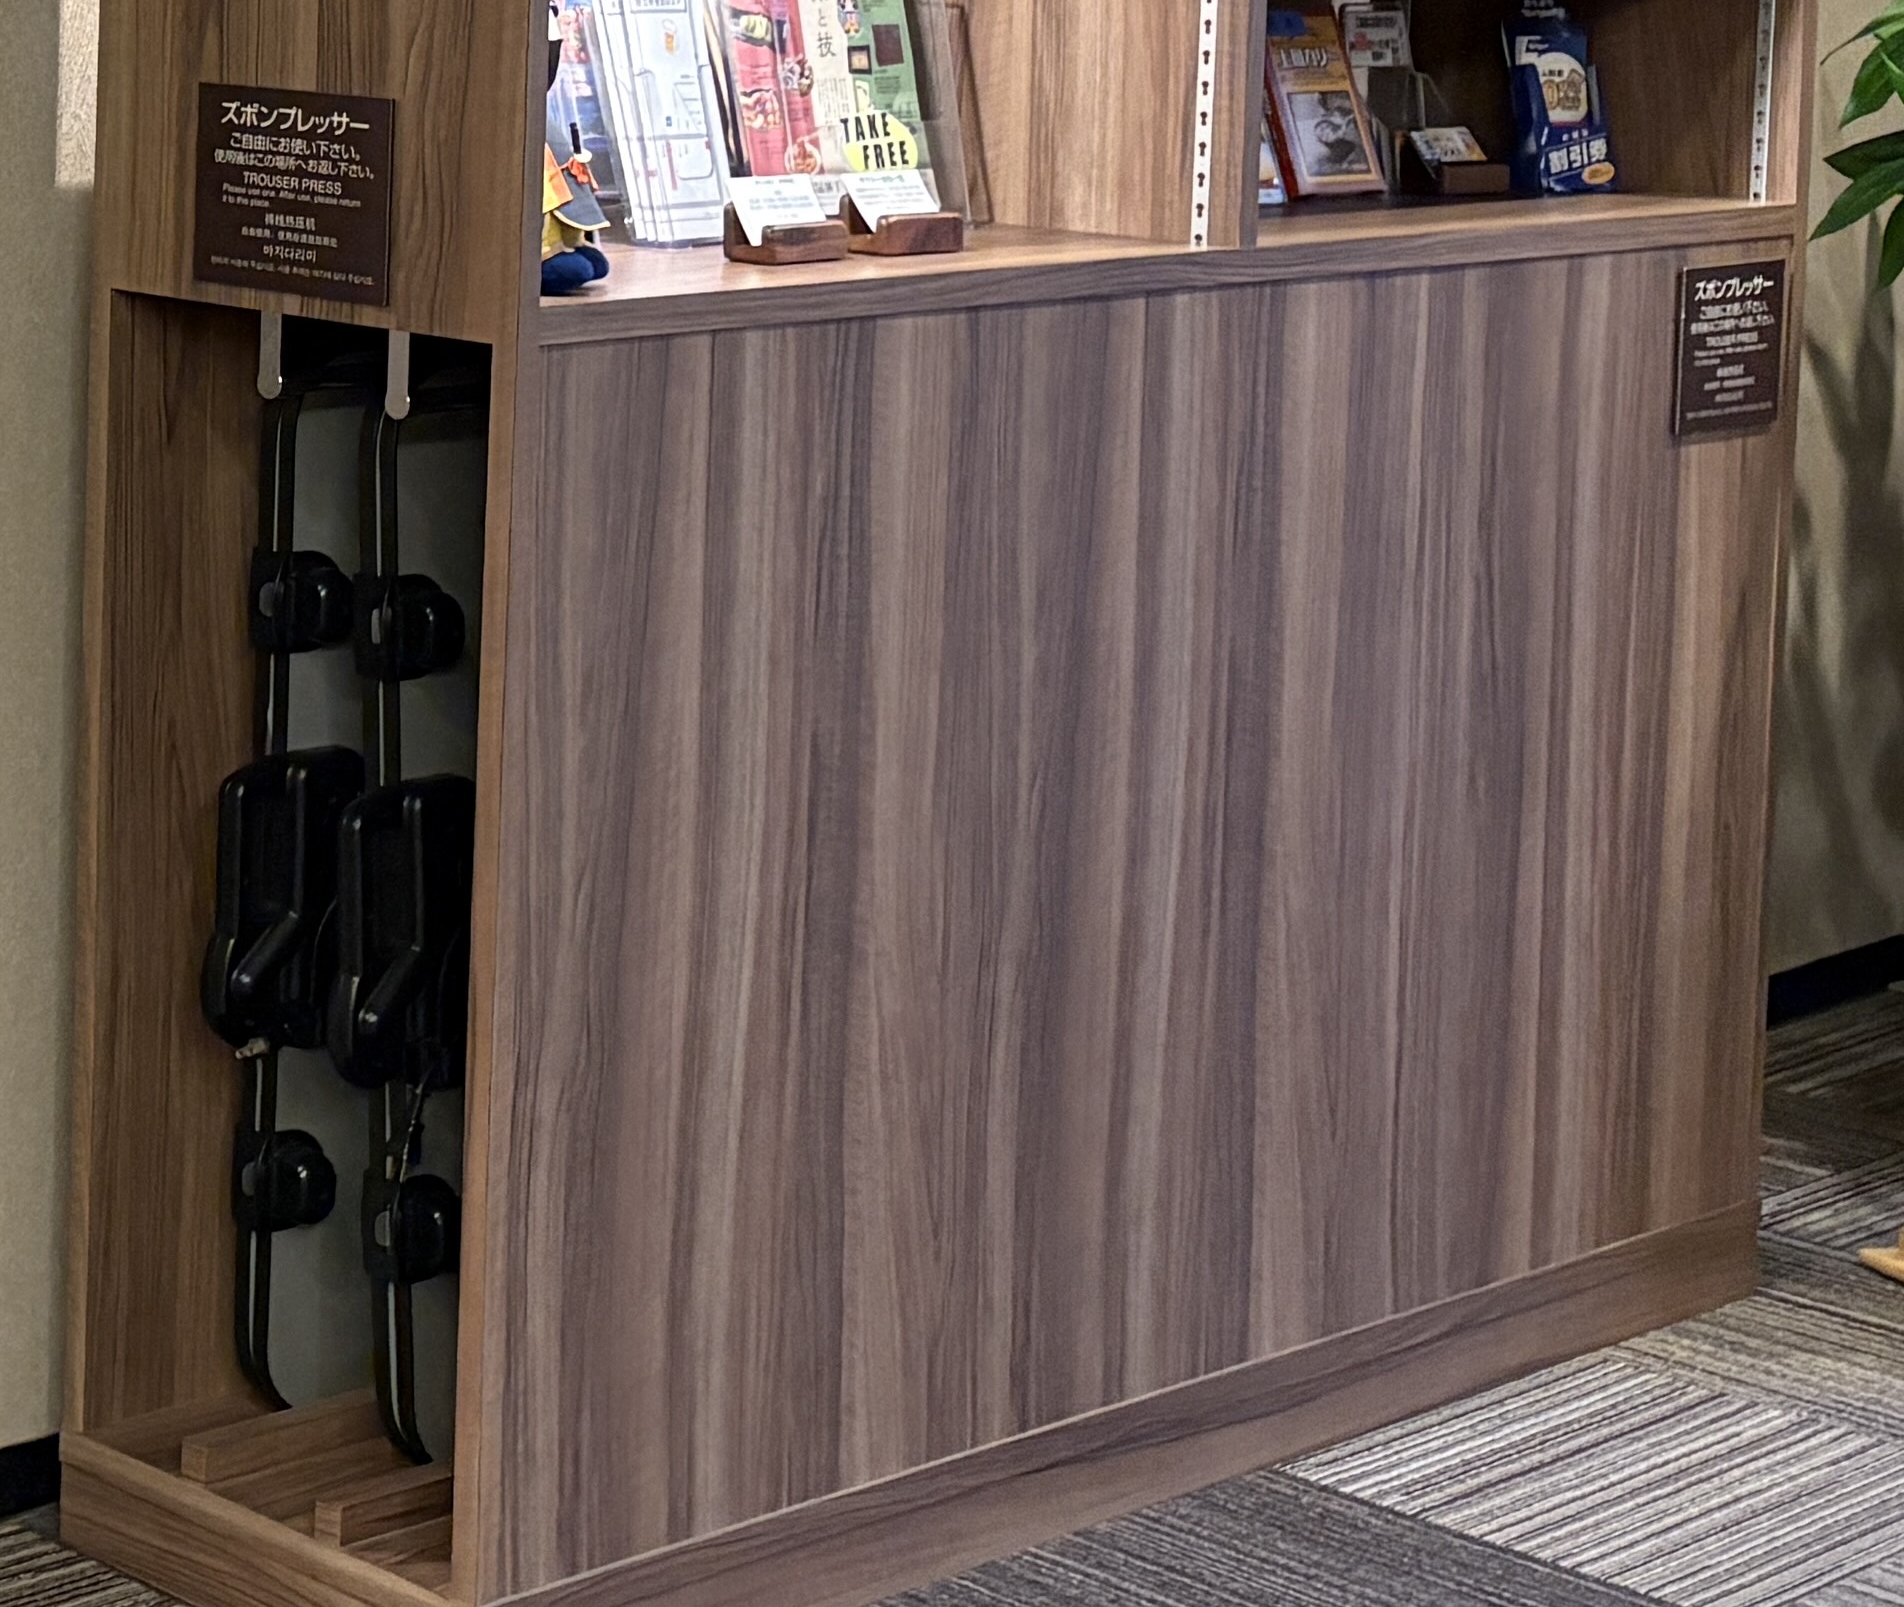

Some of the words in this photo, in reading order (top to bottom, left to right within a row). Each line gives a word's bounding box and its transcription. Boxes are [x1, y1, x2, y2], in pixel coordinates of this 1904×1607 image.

[221, 100, 370, 136] ズボンプレッサー
[840, 112, 891, 143] TAKE
[862, 140, 910, 170] FREE
[243, 171, 299, 190] TROUSER
[301, 178, 343, 195] PRESS
